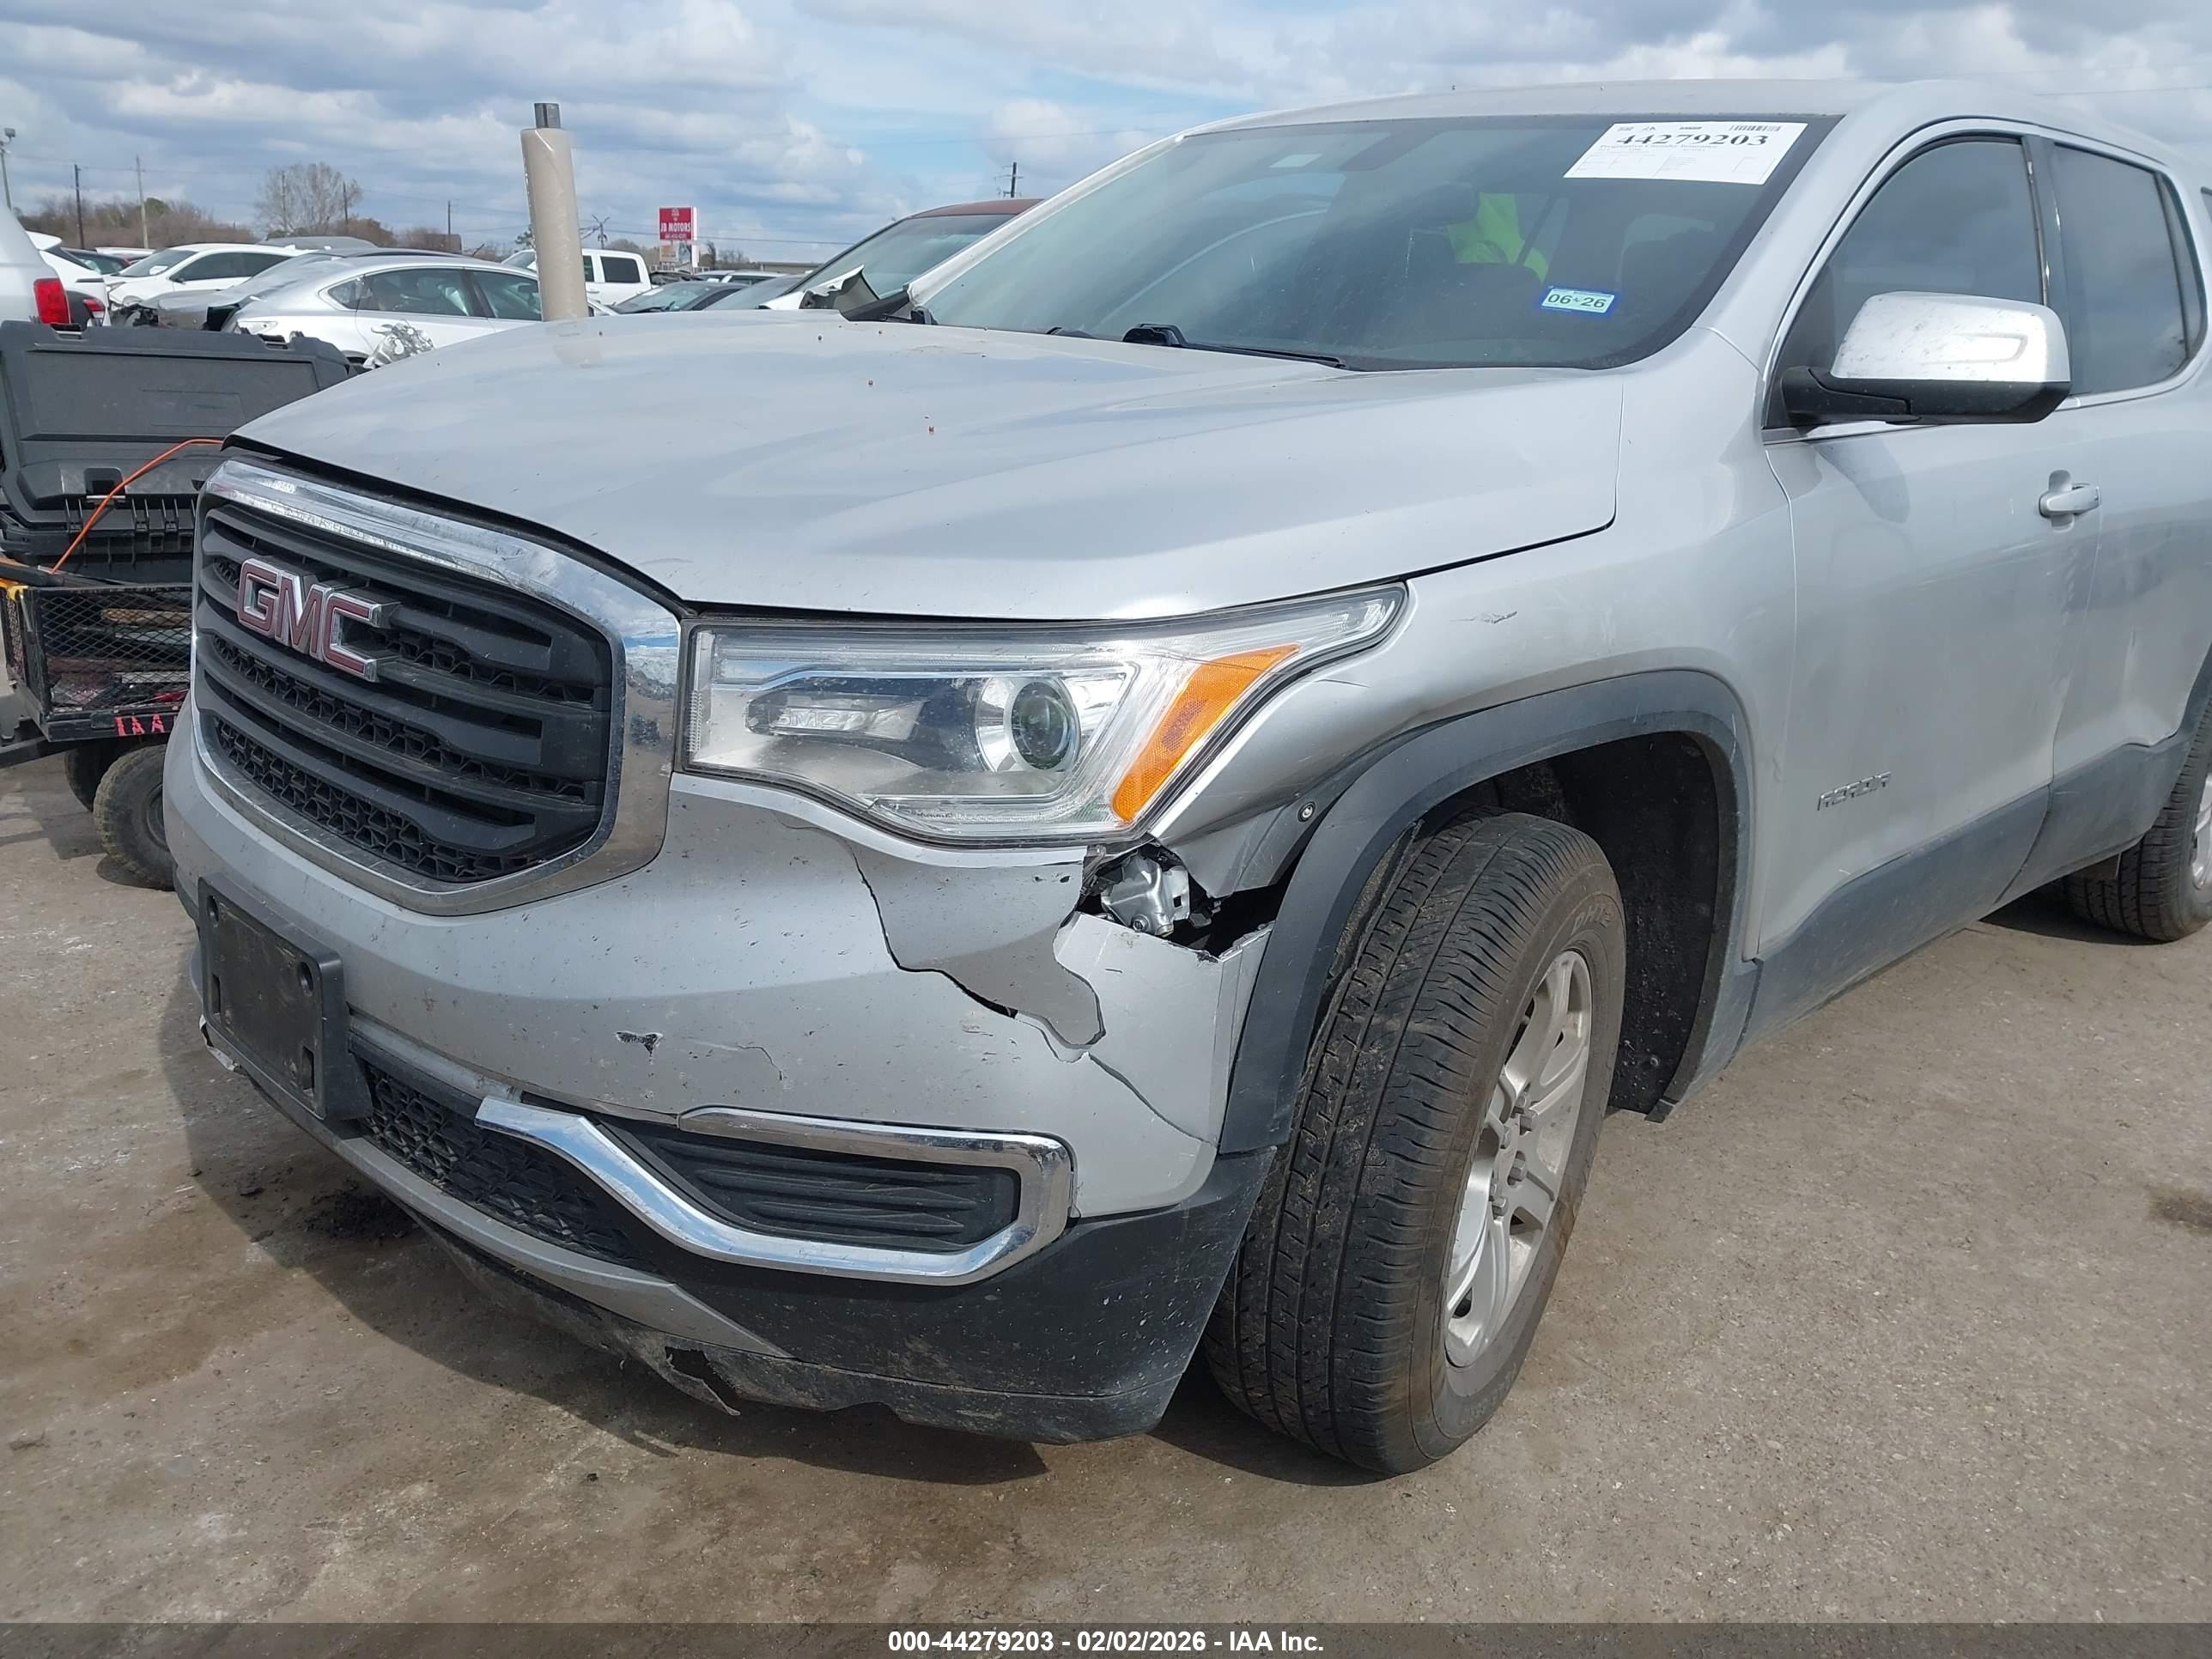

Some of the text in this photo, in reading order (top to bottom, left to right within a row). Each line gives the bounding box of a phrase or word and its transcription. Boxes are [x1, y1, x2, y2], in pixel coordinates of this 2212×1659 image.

[1616, 134, 1769, 146] 44279203
[660, 222, 691, 233] JB MOTORS
[1548, 294, 1607, 307] 06 26
[237, 558, 382, 682] GMC
